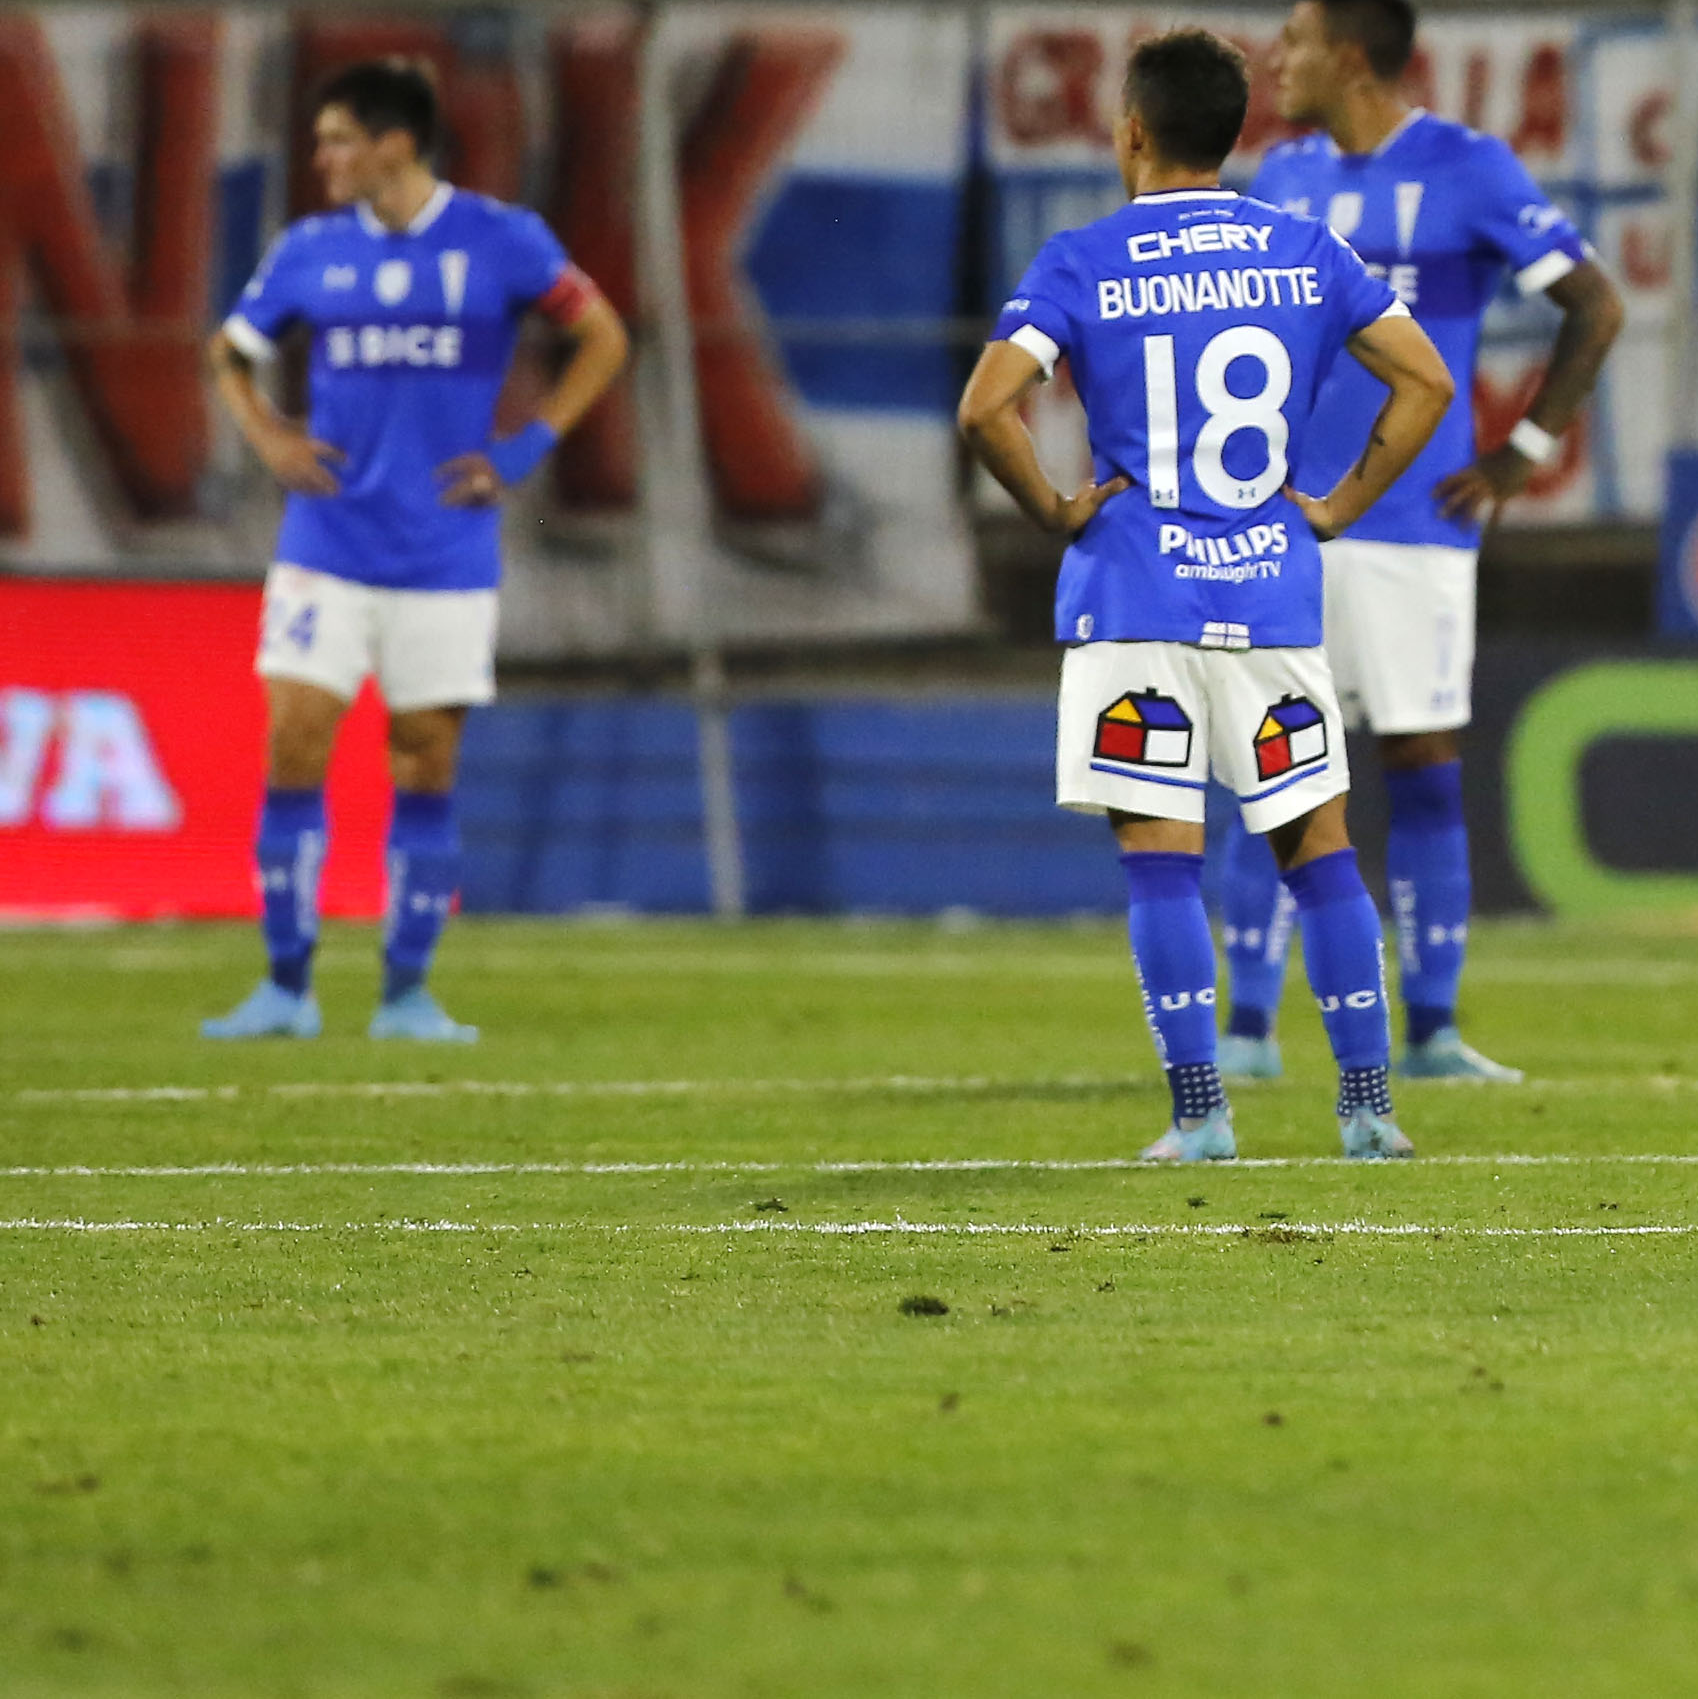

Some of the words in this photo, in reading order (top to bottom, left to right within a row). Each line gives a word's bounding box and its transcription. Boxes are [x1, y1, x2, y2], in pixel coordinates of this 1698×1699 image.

[1127, 223, 1272, 263] CHERY
[1099, 266, 1322, 320] BUONANOTTE
[1143, 324, 1292, 510] 18
[1158, 522, 1289, 566] PHILIPS
